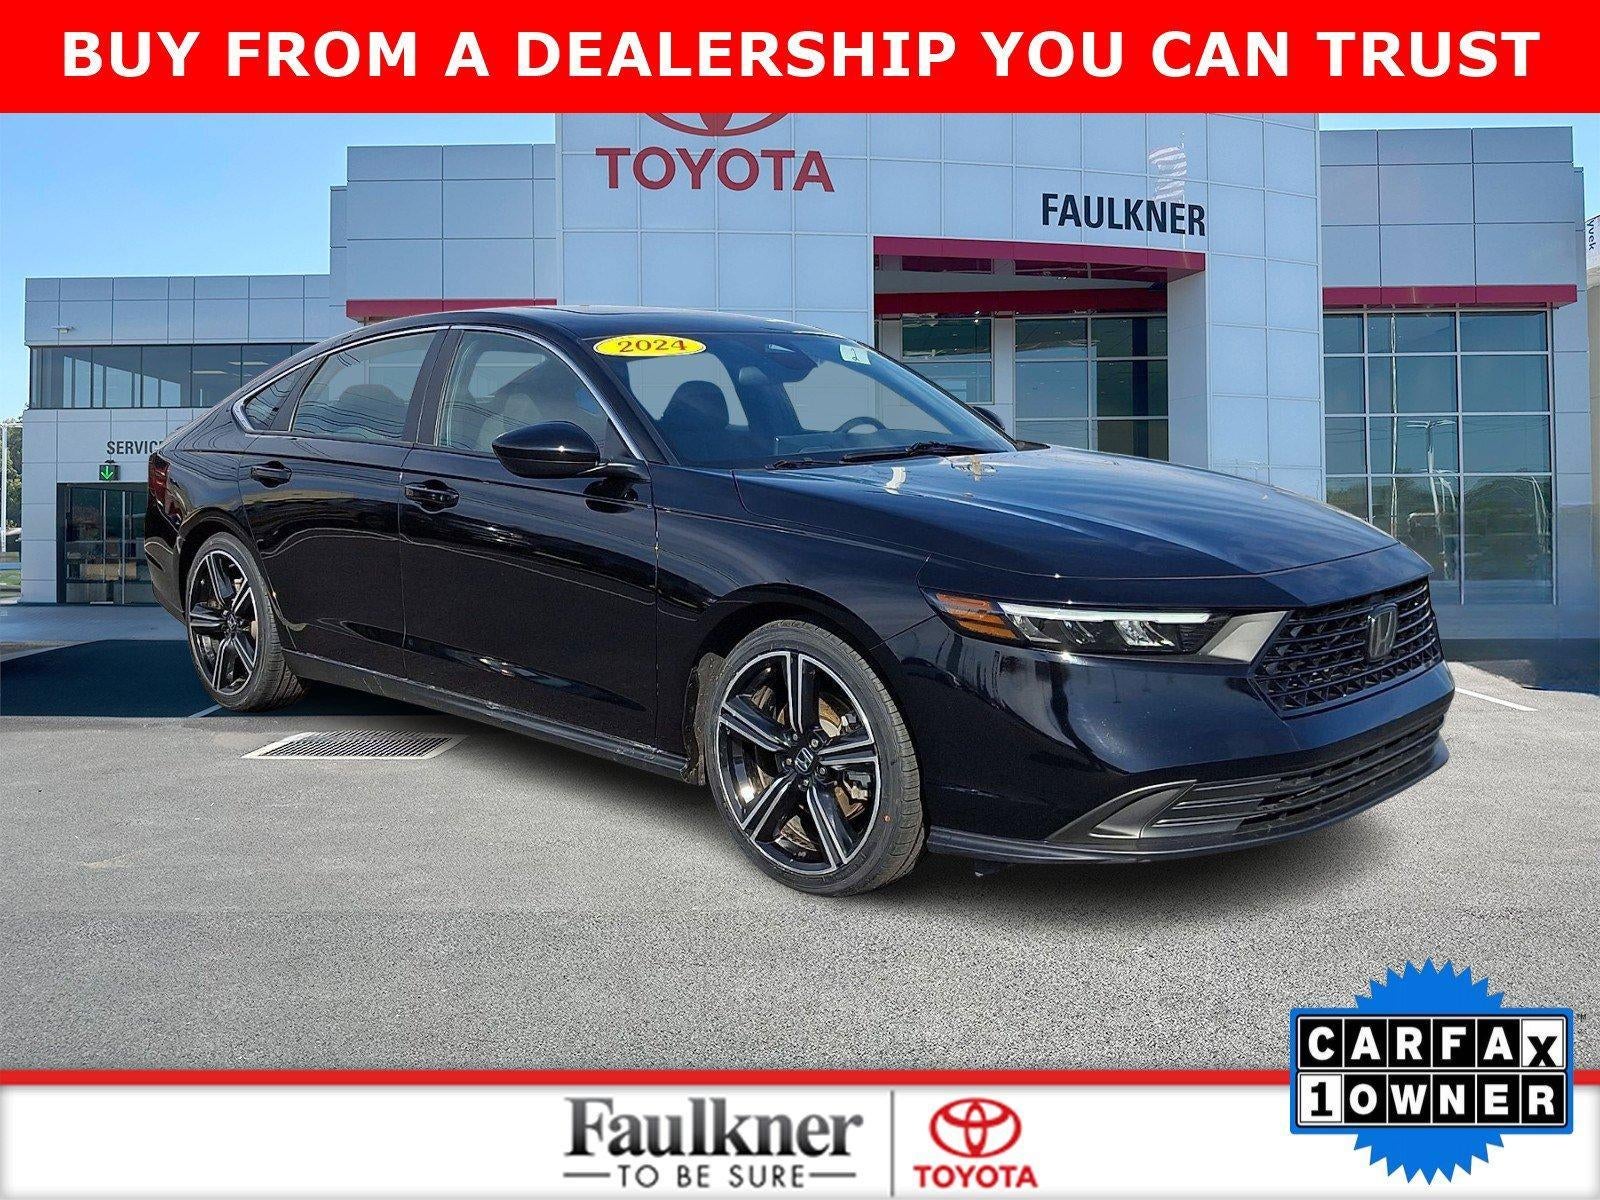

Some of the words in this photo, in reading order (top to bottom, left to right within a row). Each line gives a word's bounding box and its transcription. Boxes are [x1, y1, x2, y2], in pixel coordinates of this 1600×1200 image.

[596, 146, 835, 193] TOYOTA
[1042, 193, 1206, 237] FAULKNER
[618, 339, 687, 353] 2024
[106, 440, 164, 455] SERVIC
